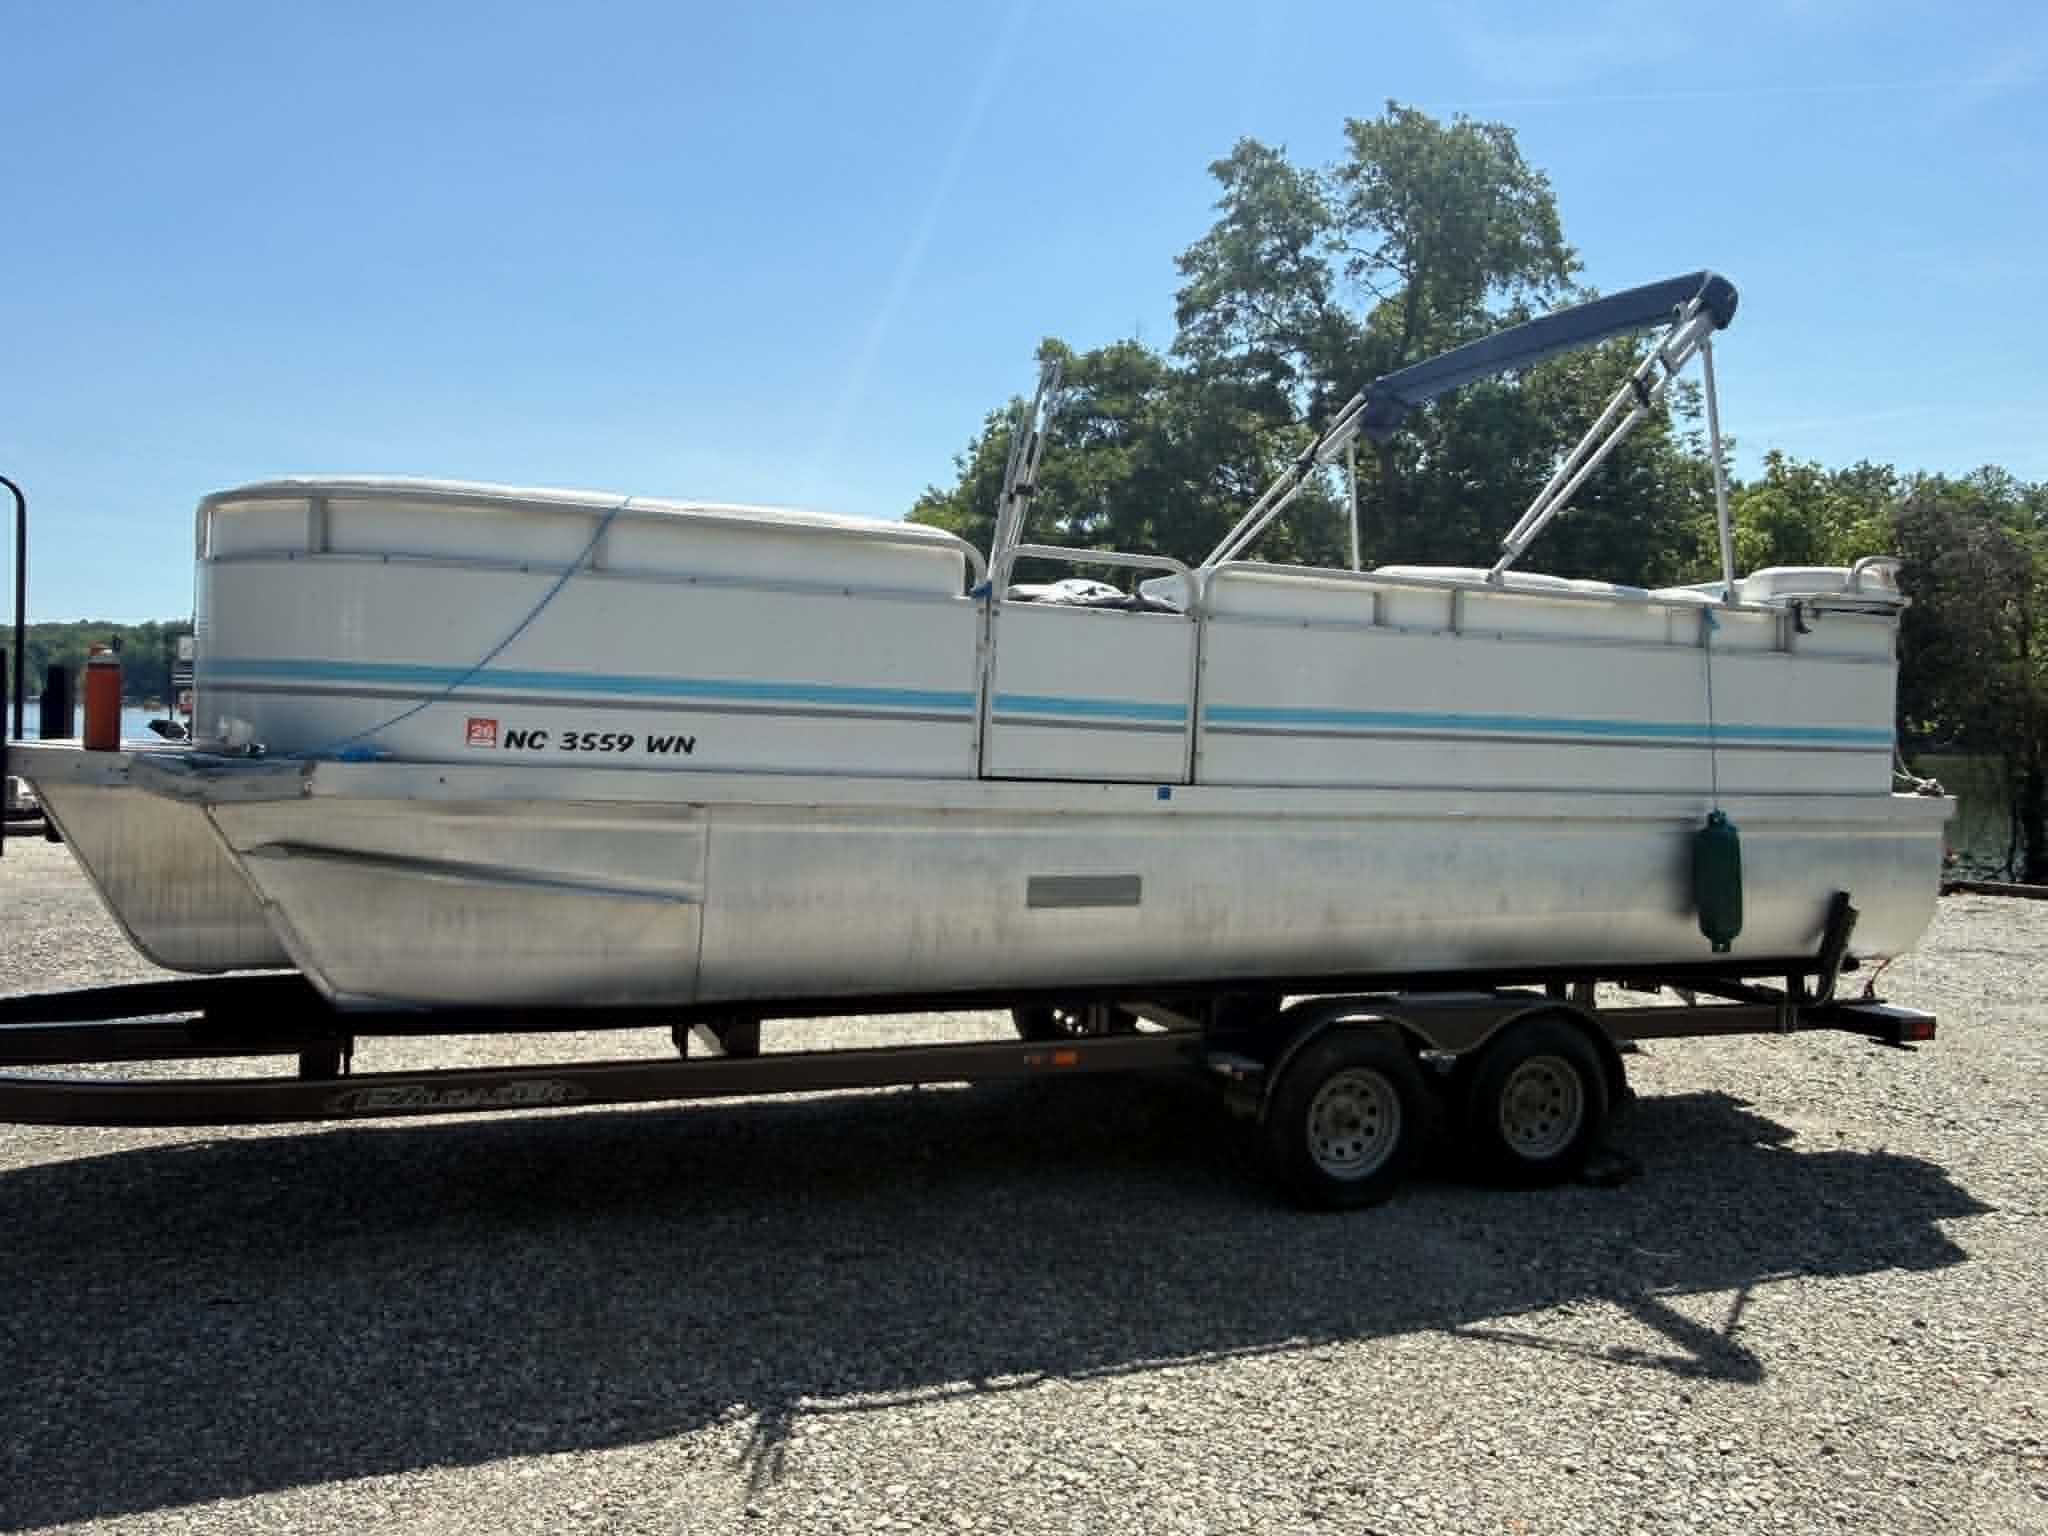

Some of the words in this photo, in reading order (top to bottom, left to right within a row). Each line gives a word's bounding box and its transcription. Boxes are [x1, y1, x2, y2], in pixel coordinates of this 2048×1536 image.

[504, 730, 548, 749] NC
[559, 732, 635, 752] 3559
[647, 735, 696, 754] WN
